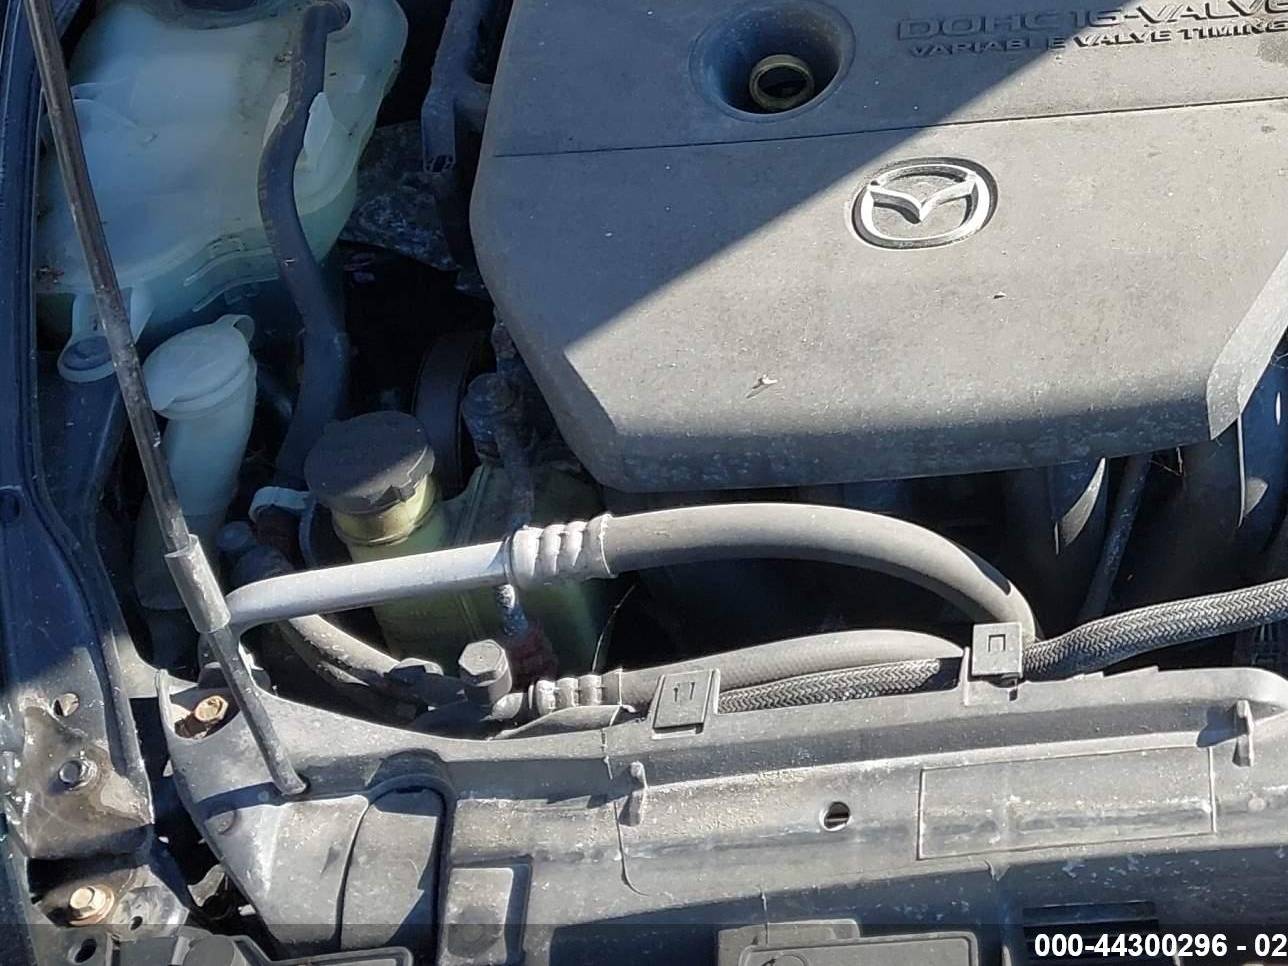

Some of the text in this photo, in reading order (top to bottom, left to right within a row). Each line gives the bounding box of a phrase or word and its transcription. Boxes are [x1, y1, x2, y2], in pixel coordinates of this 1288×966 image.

[898, 9, 1065, 41] DOHC
[912, 34, 1067, 57] VARIABLE
[1072, 27, 1173, 48] VALVE
